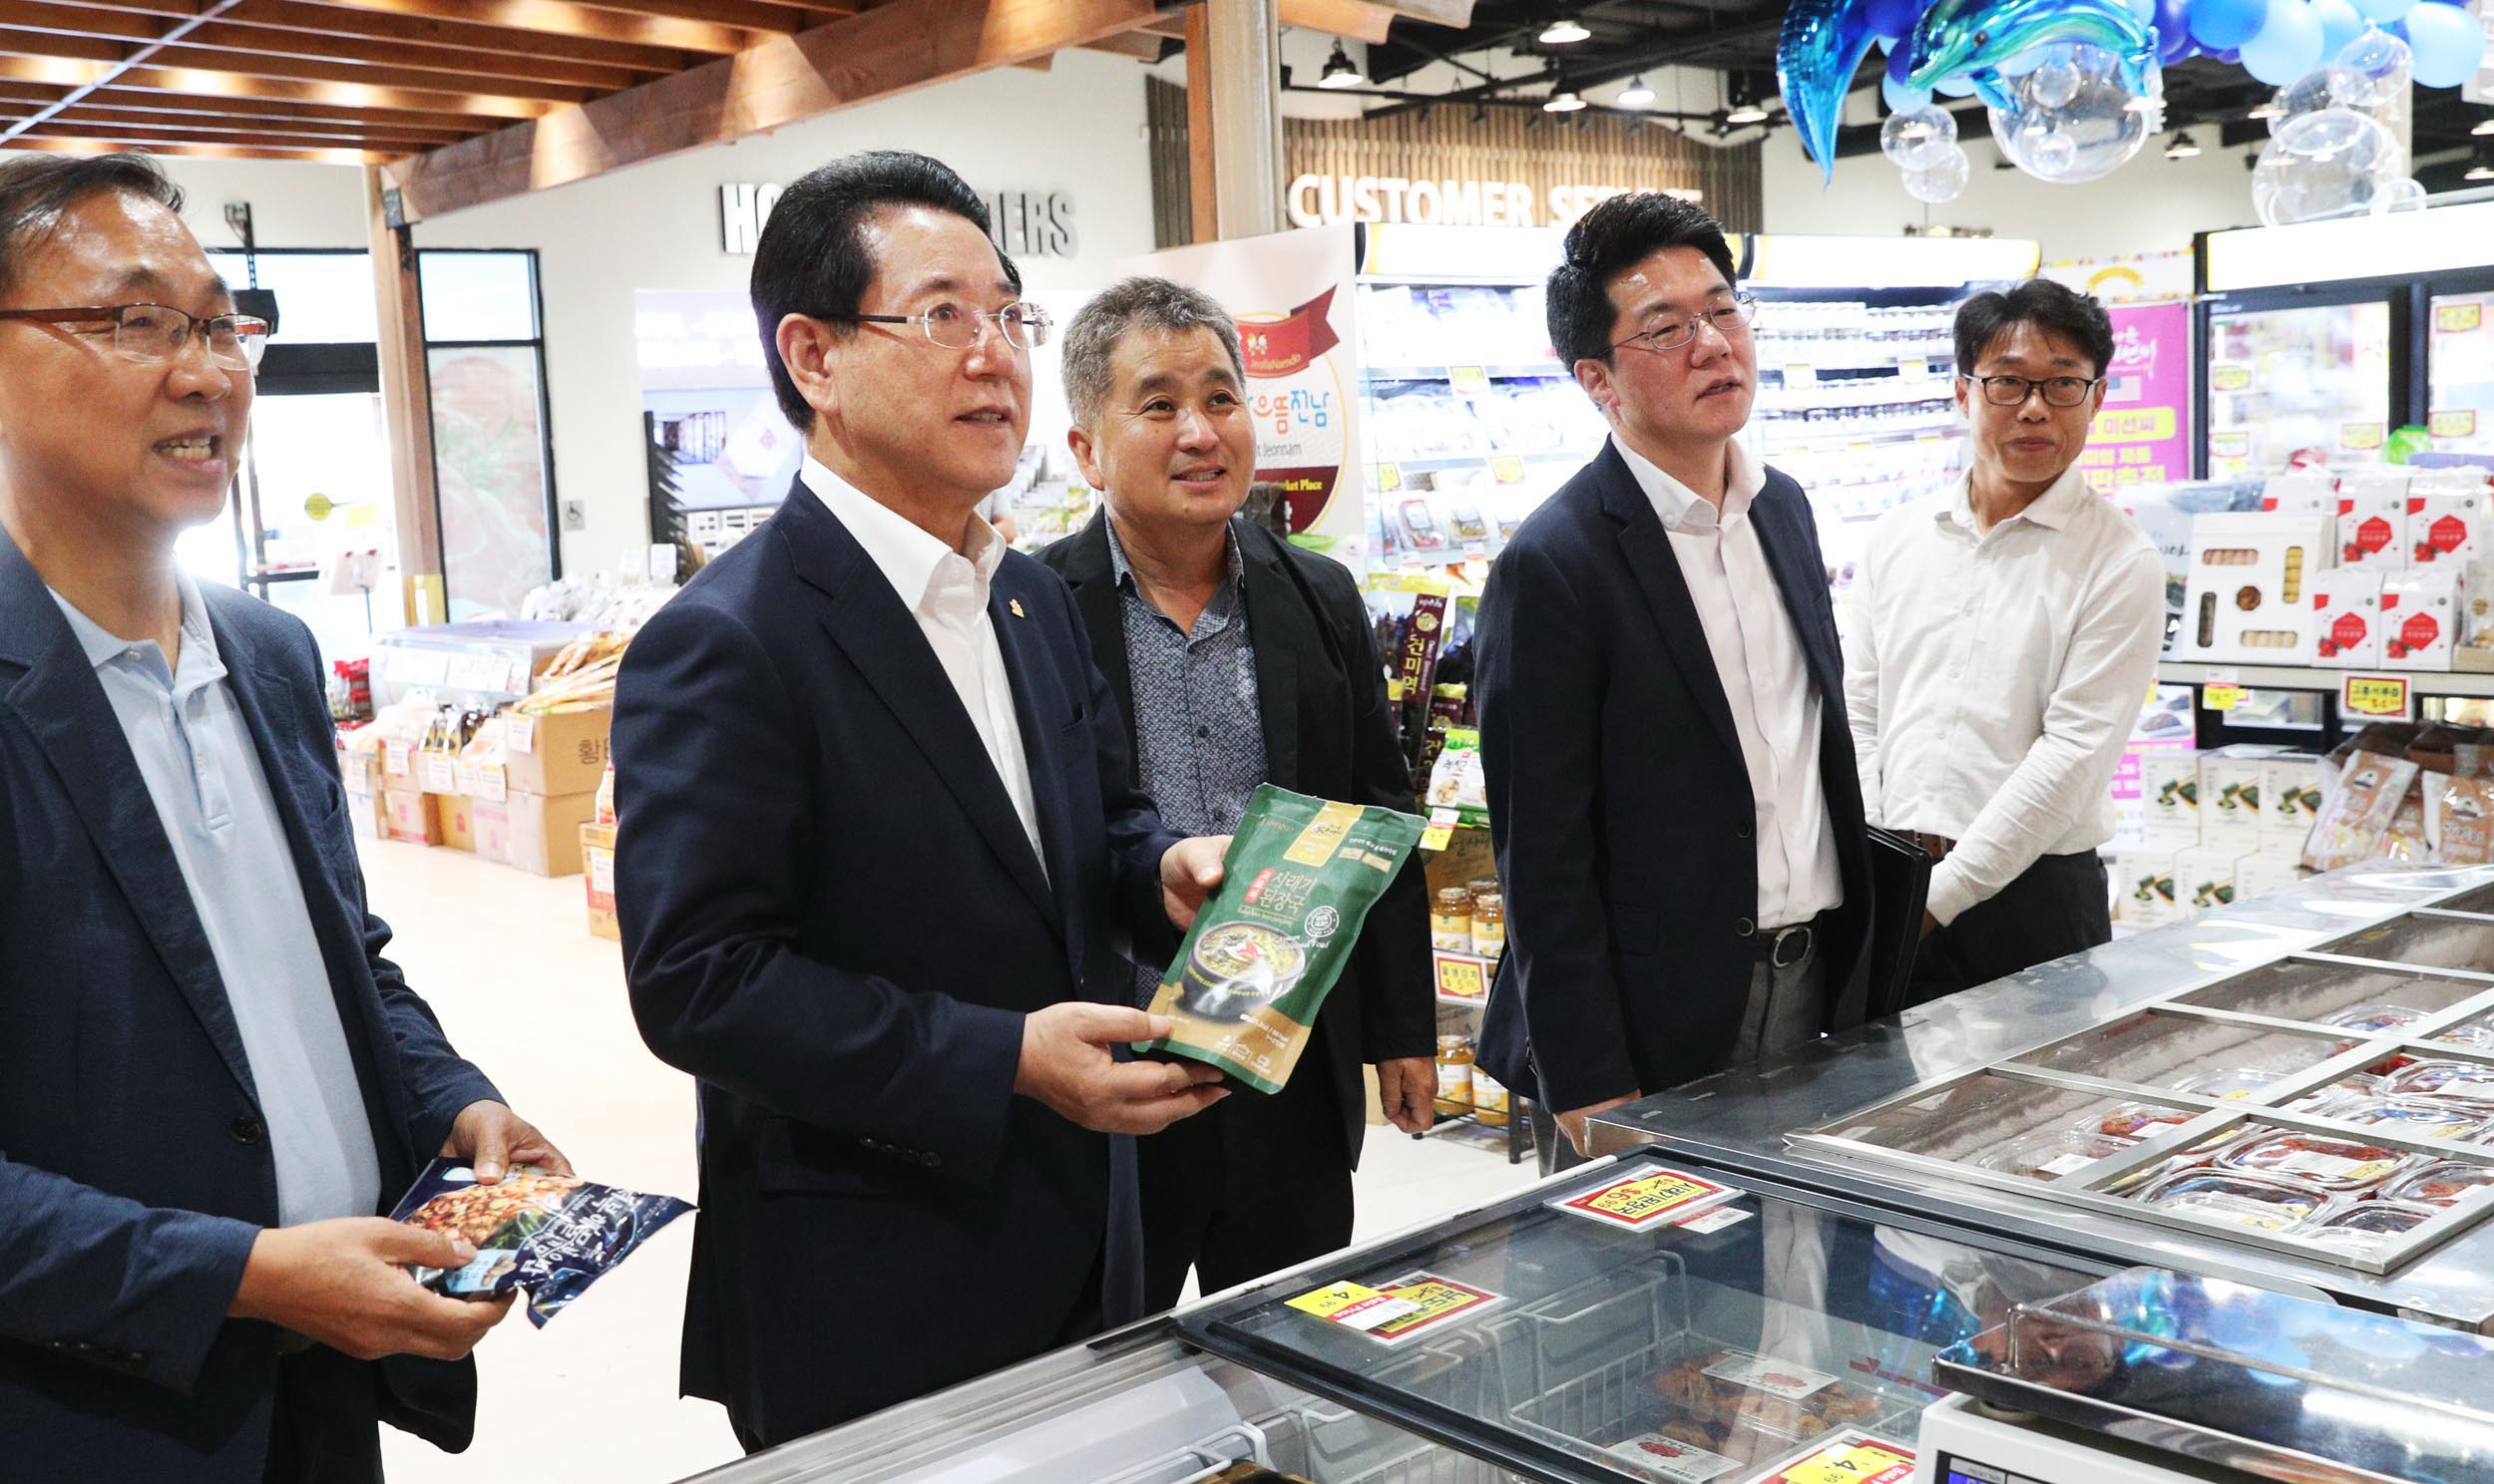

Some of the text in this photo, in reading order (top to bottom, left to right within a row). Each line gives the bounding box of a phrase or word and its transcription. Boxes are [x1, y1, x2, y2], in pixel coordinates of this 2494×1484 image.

[1287, 174, 1532, 227] CUSTOMER
[1299, 478, 1323, 491] Place
[1403, 637, 1426, 695] 건미역
[1271, 870, 1319, 897] 시래기
[1259, 888, 1307, 916] 된장국
[1613, 1182, 1697, 1215] 시래기된장국
[1333, 1296, 1388, 1317] Sale Price
